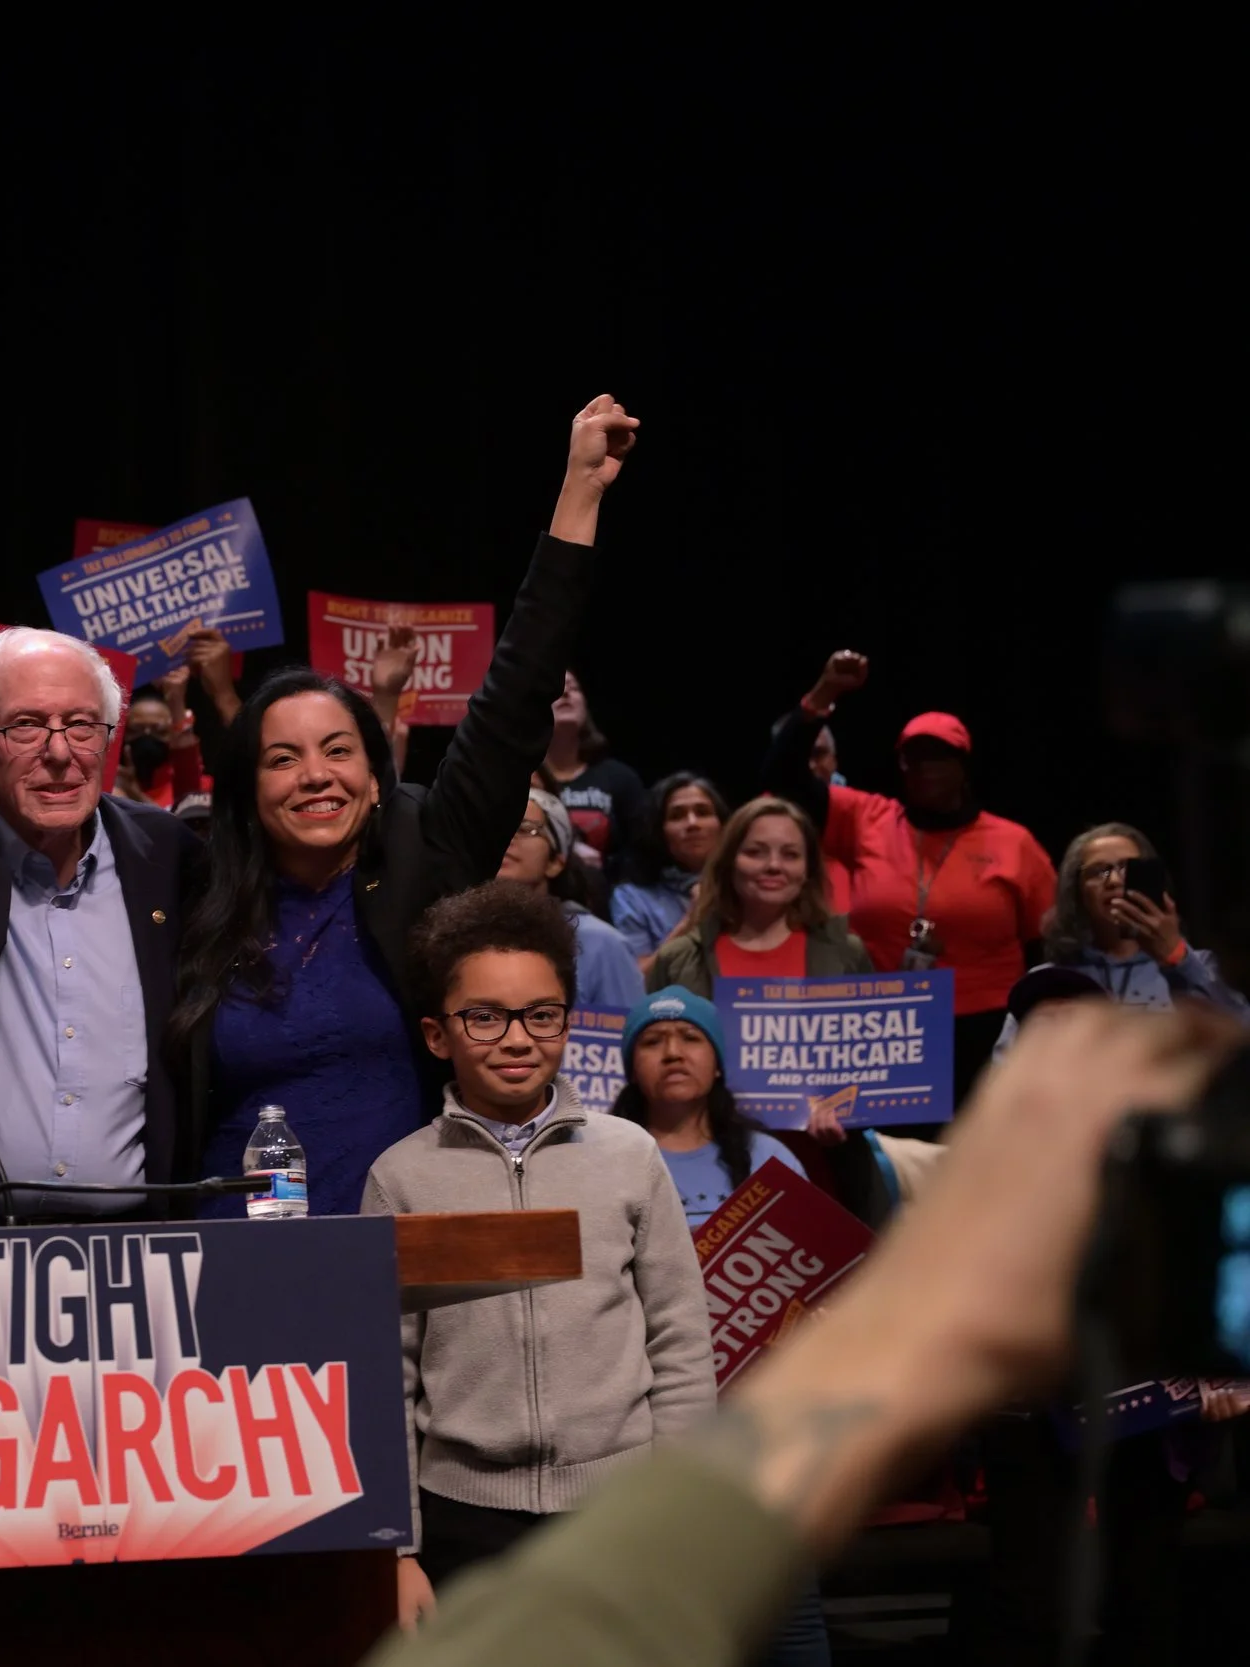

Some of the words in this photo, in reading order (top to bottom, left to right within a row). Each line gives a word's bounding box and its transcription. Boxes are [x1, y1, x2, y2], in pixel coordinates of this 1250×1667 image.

[72, 539, 243, 617] UNIVERSAL
[81, 565, 251, 641] HEALTHCARE
[116, 624, 148, 647] AND
[342, 627, 452, 664] UNON
[740, 1008, 925, 1043] UNIVERSAL
[740, 1038, 924, 1070] HEALTHCARE
[767, 1073, 802, 1086] AND
[806, 1069, 889, 1086] CHILDCARE
[705, 1221, 796, 1334] NION
[58, 1520, 120, 1539] Bernie
